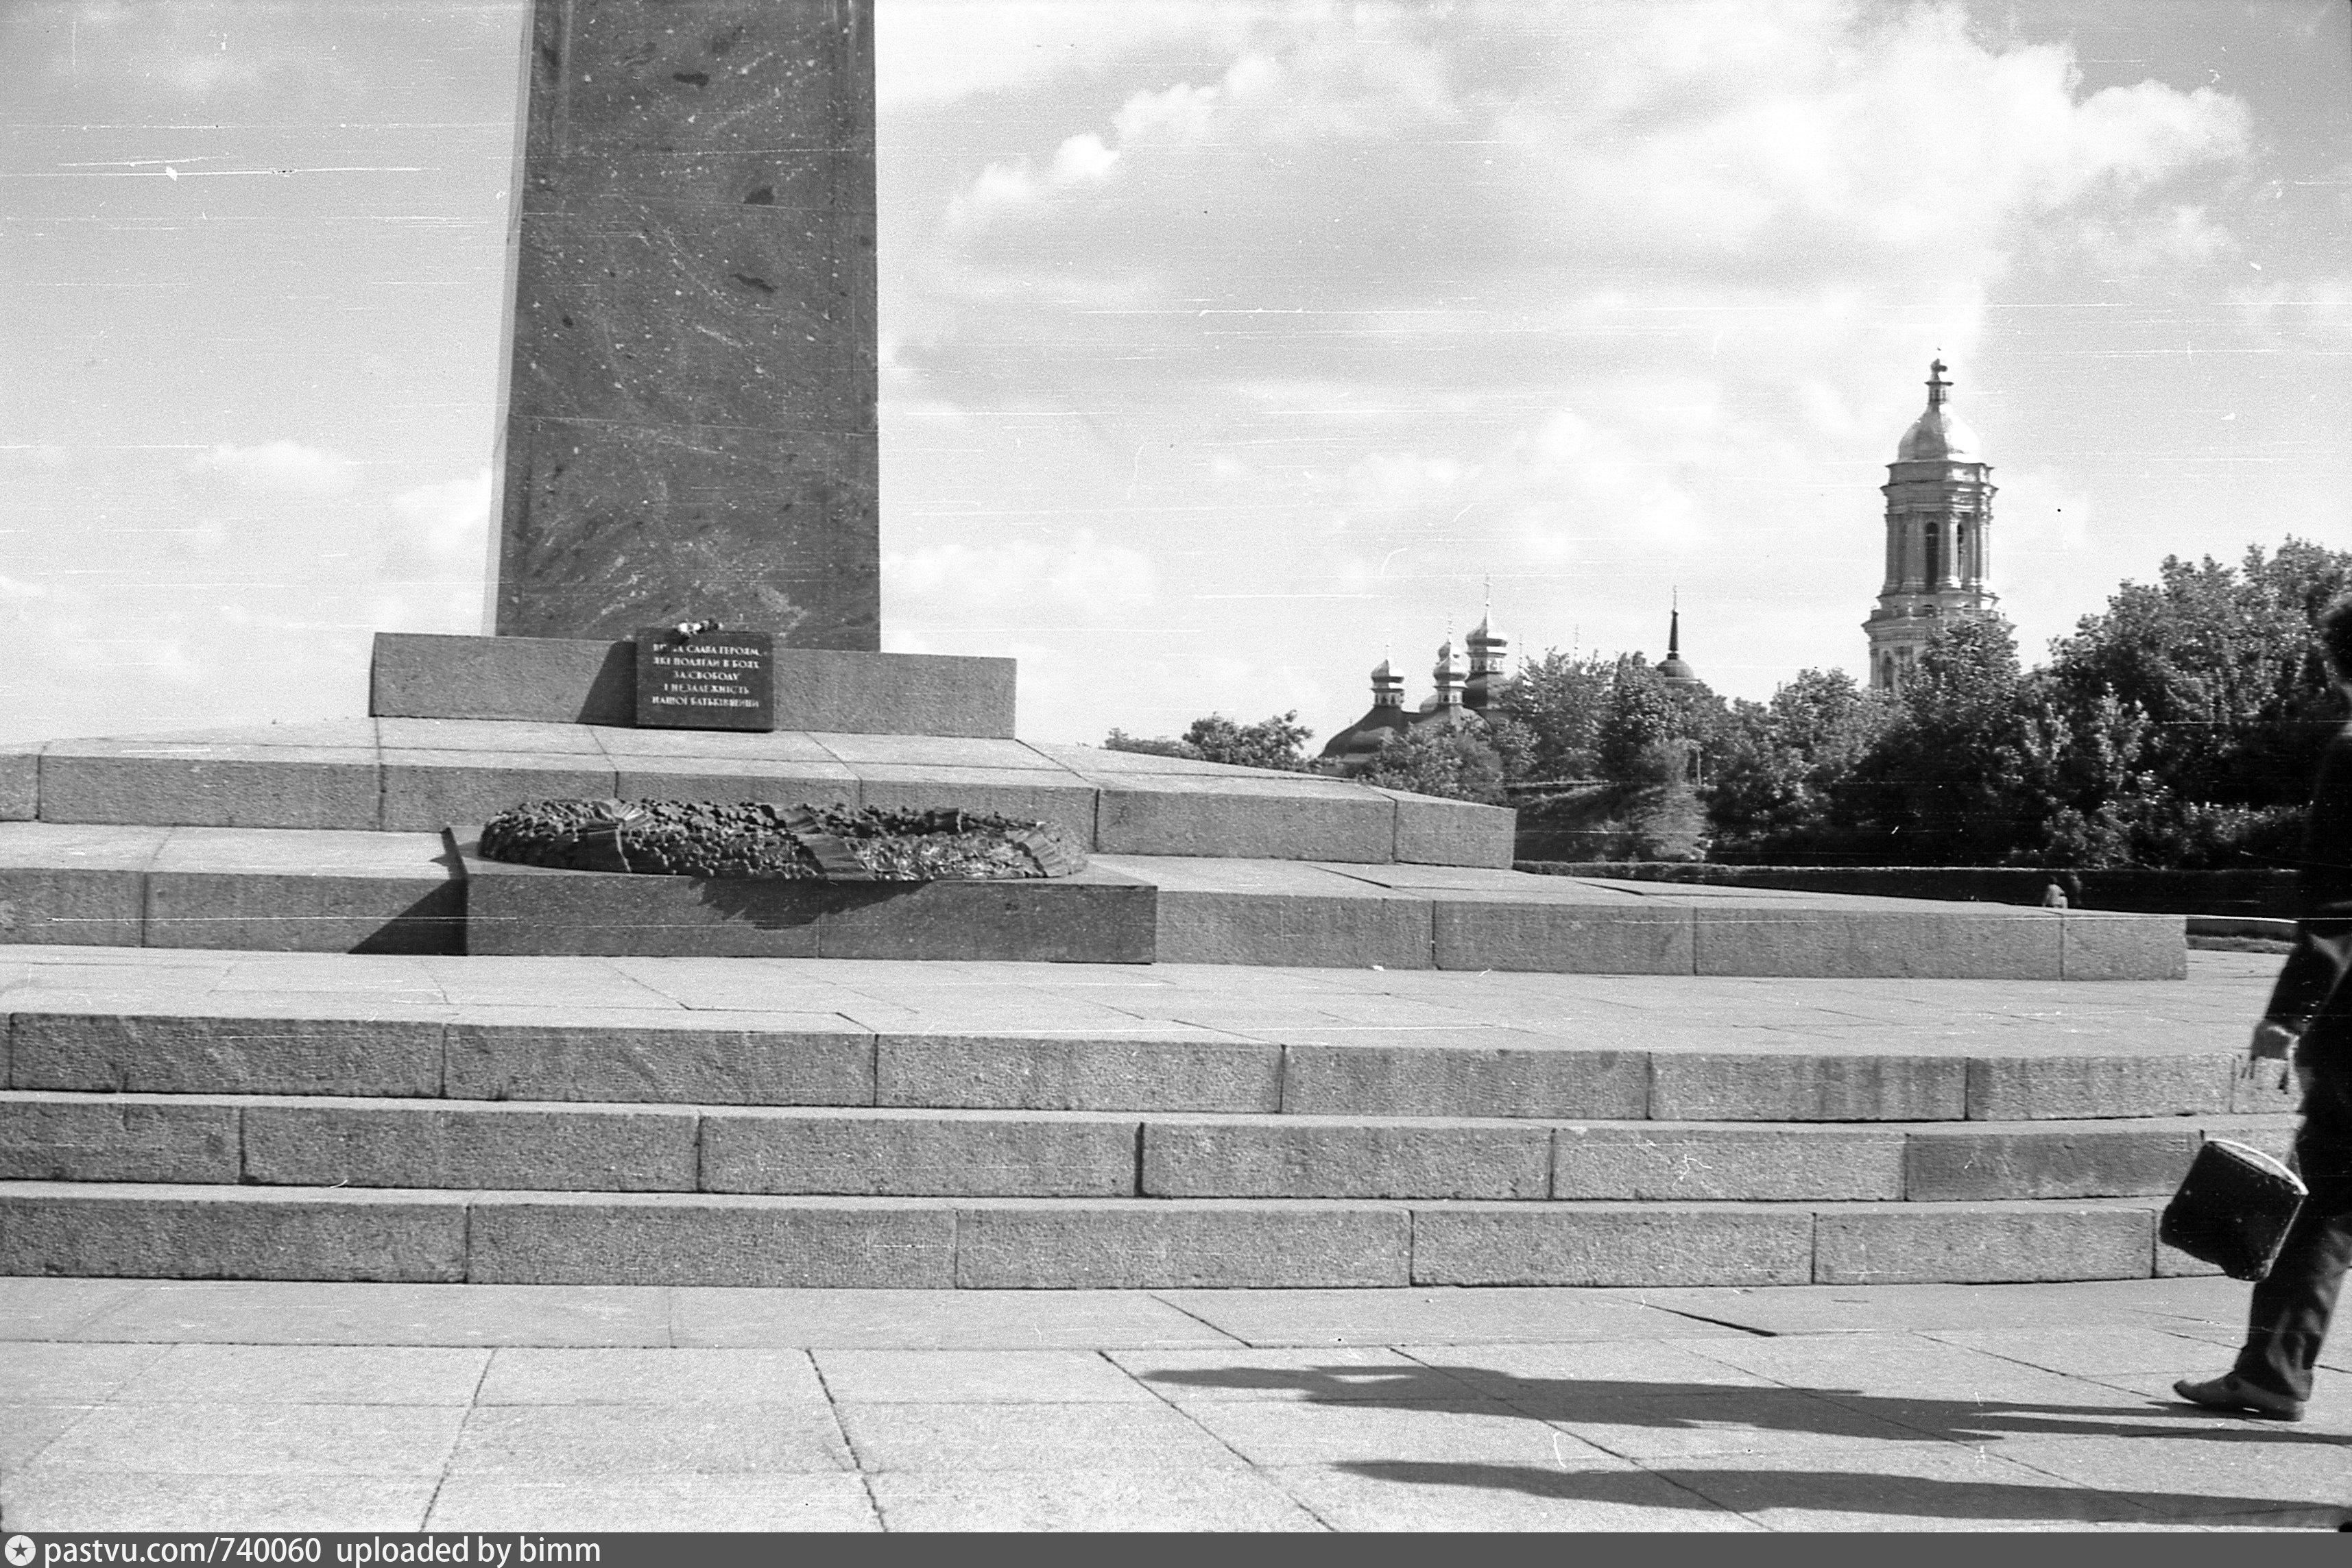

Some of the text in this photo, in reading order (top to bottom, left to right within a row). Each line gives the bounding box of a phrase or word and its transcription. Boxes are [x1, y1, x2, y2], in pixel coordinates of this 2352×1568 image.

[653, 643, 684, 653] ВІА
[686, 644, 717, 654] СЛАВА
[653, 657, 760, 668] ЯКІ ПОЛЯГЛИ В БОЯХ
[673, 670, 741, 681] ЗА СВОБОДУ
[664, 683, 750, 694] І НЕЗАЛЕЖНІСТЬ
[652, 695, 760, 708] НАШОЇ БАТЬКІВЩИНИ
